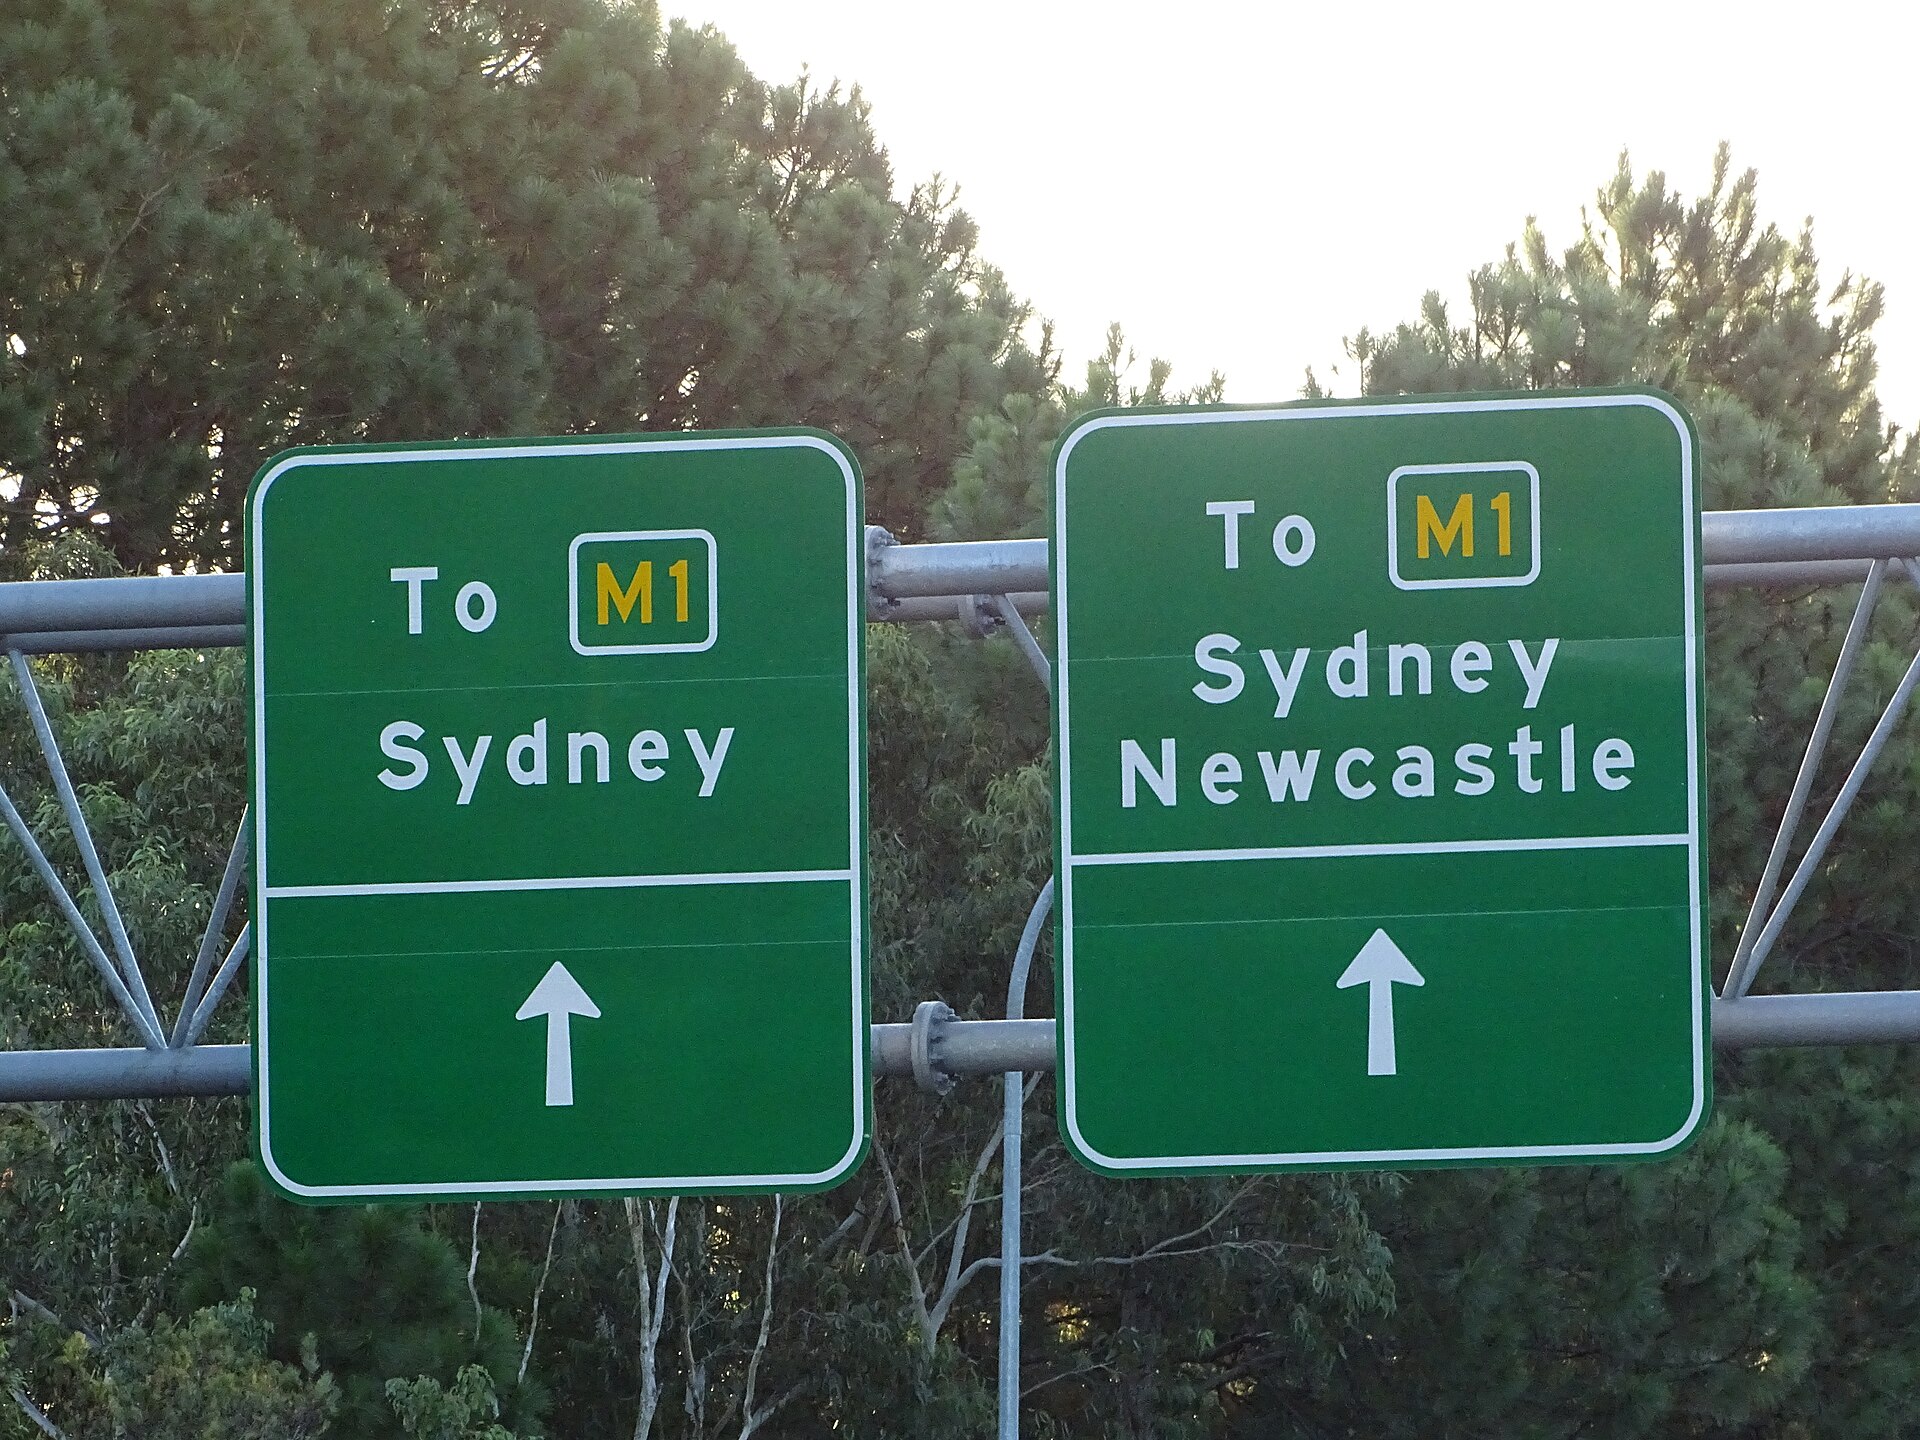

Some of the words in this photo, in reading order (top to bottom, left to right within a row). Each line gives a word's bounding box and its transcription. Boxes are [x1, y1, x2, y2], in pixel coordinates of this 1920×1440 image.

[1205, 499, 1316, 570] To
[1416, 491, 1512, 559] M1
[390, 566, 497, 635] To
[596, 560, 689, 625] M1
[1191, 628, 1560, 718] Sydney
[377, 717, 735, 805] Sydney
[1120, 722, 1635, 808] Newcastle
